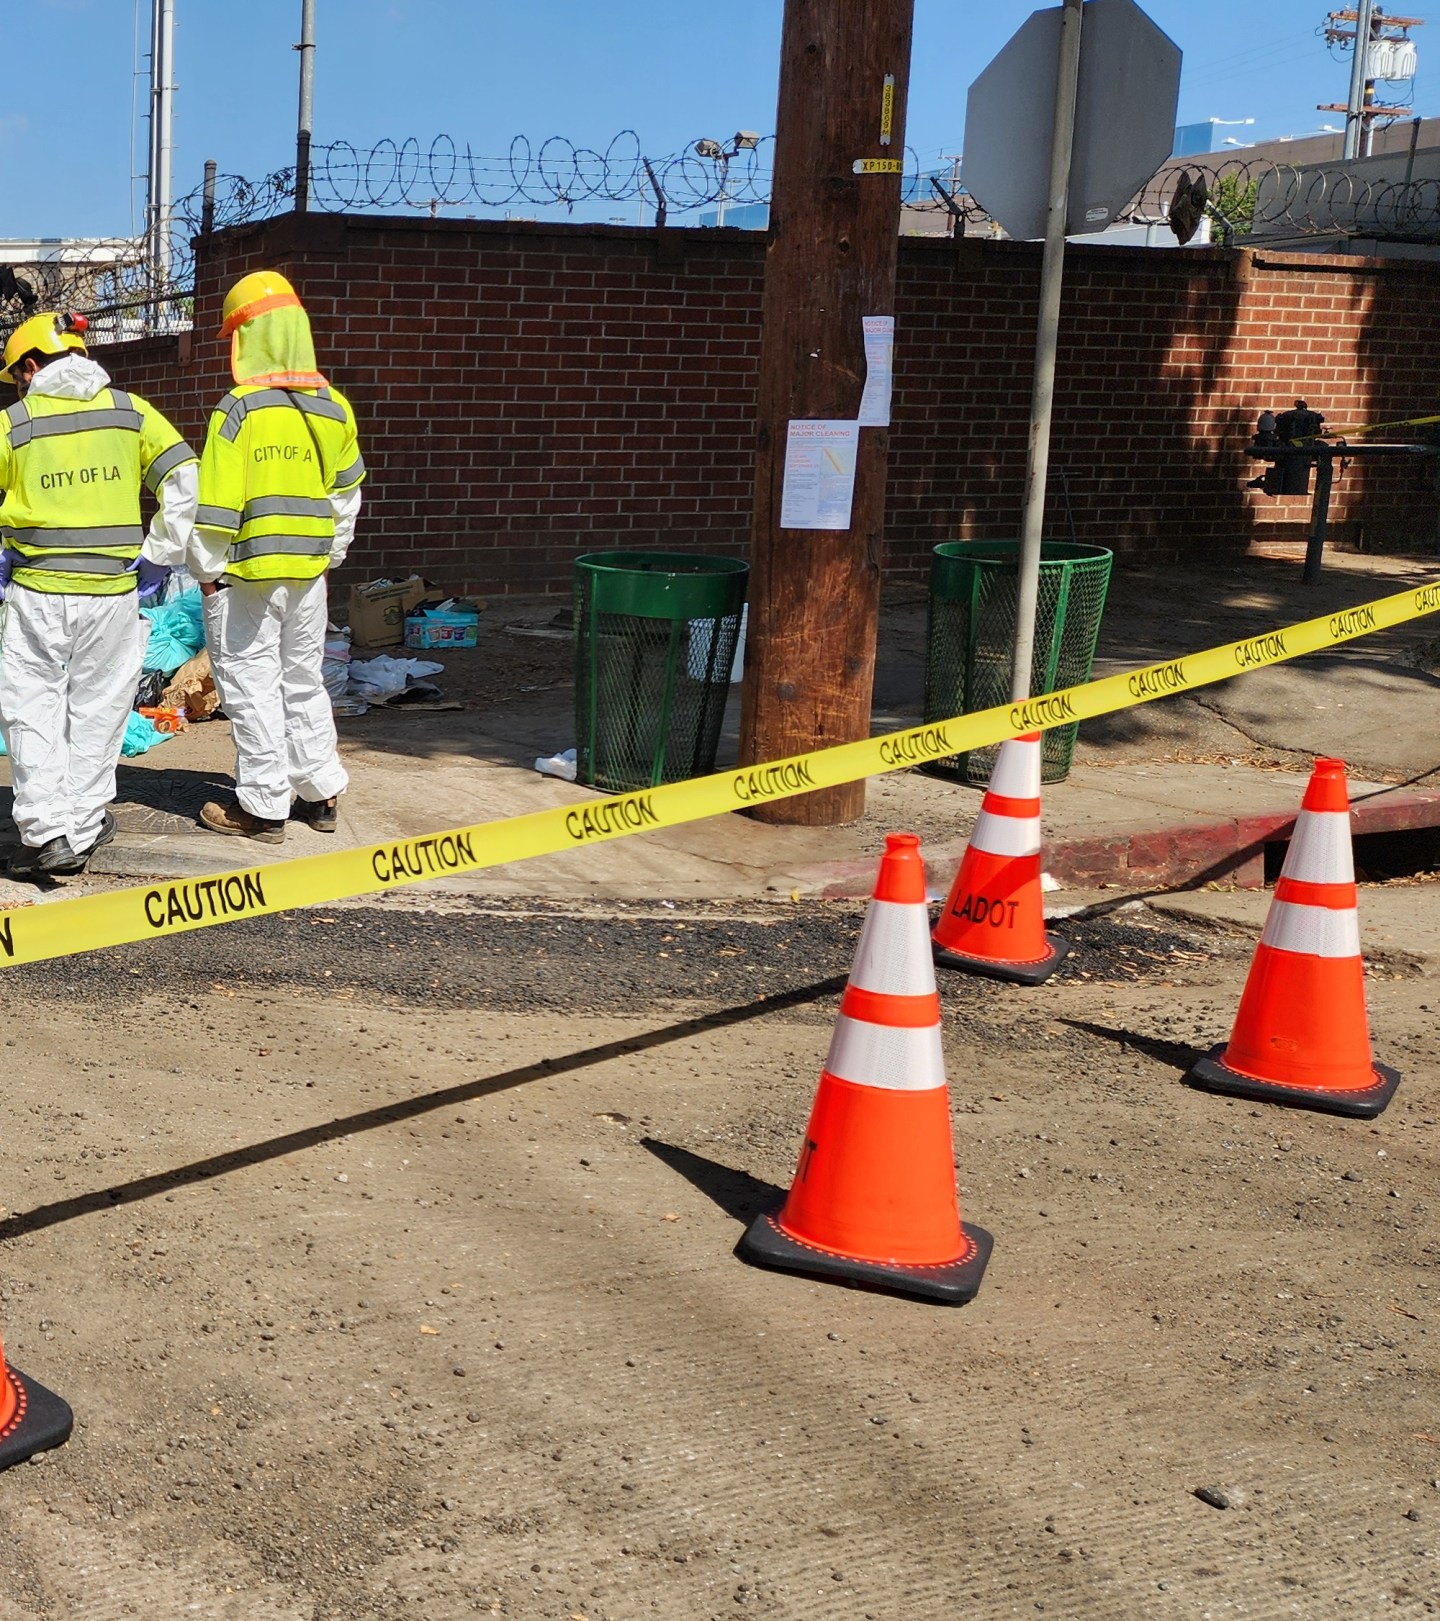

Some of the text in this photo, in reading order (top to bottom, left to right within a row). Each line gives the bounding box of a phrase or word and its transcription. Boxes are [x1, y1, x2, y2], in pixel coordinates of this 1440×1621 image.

[253, 445, 281, 463] CITY
[283, 445, 299, 460] OF
[40, 464, 122, 490] CITY OF LA
[143, 871, 267, 930] CAUTION
[372, 833, 477, 882] CAUTION
[565, 795, 659, 840] CAUTION
[733, 759, 816, 801] CAUTION
[878, 726, 953, 765] CAUTION
[1009, 693, 1075, 732] CAUTION
[1127, 662, 1188, 698] CAUTION
[1234, 632, 1285, 669] CAUTION
[1329, 605, 1376, 638] CAUTION
[1415, 586, 1440, 611] CAUT
[950, 889, 1019, 929] LADOT
